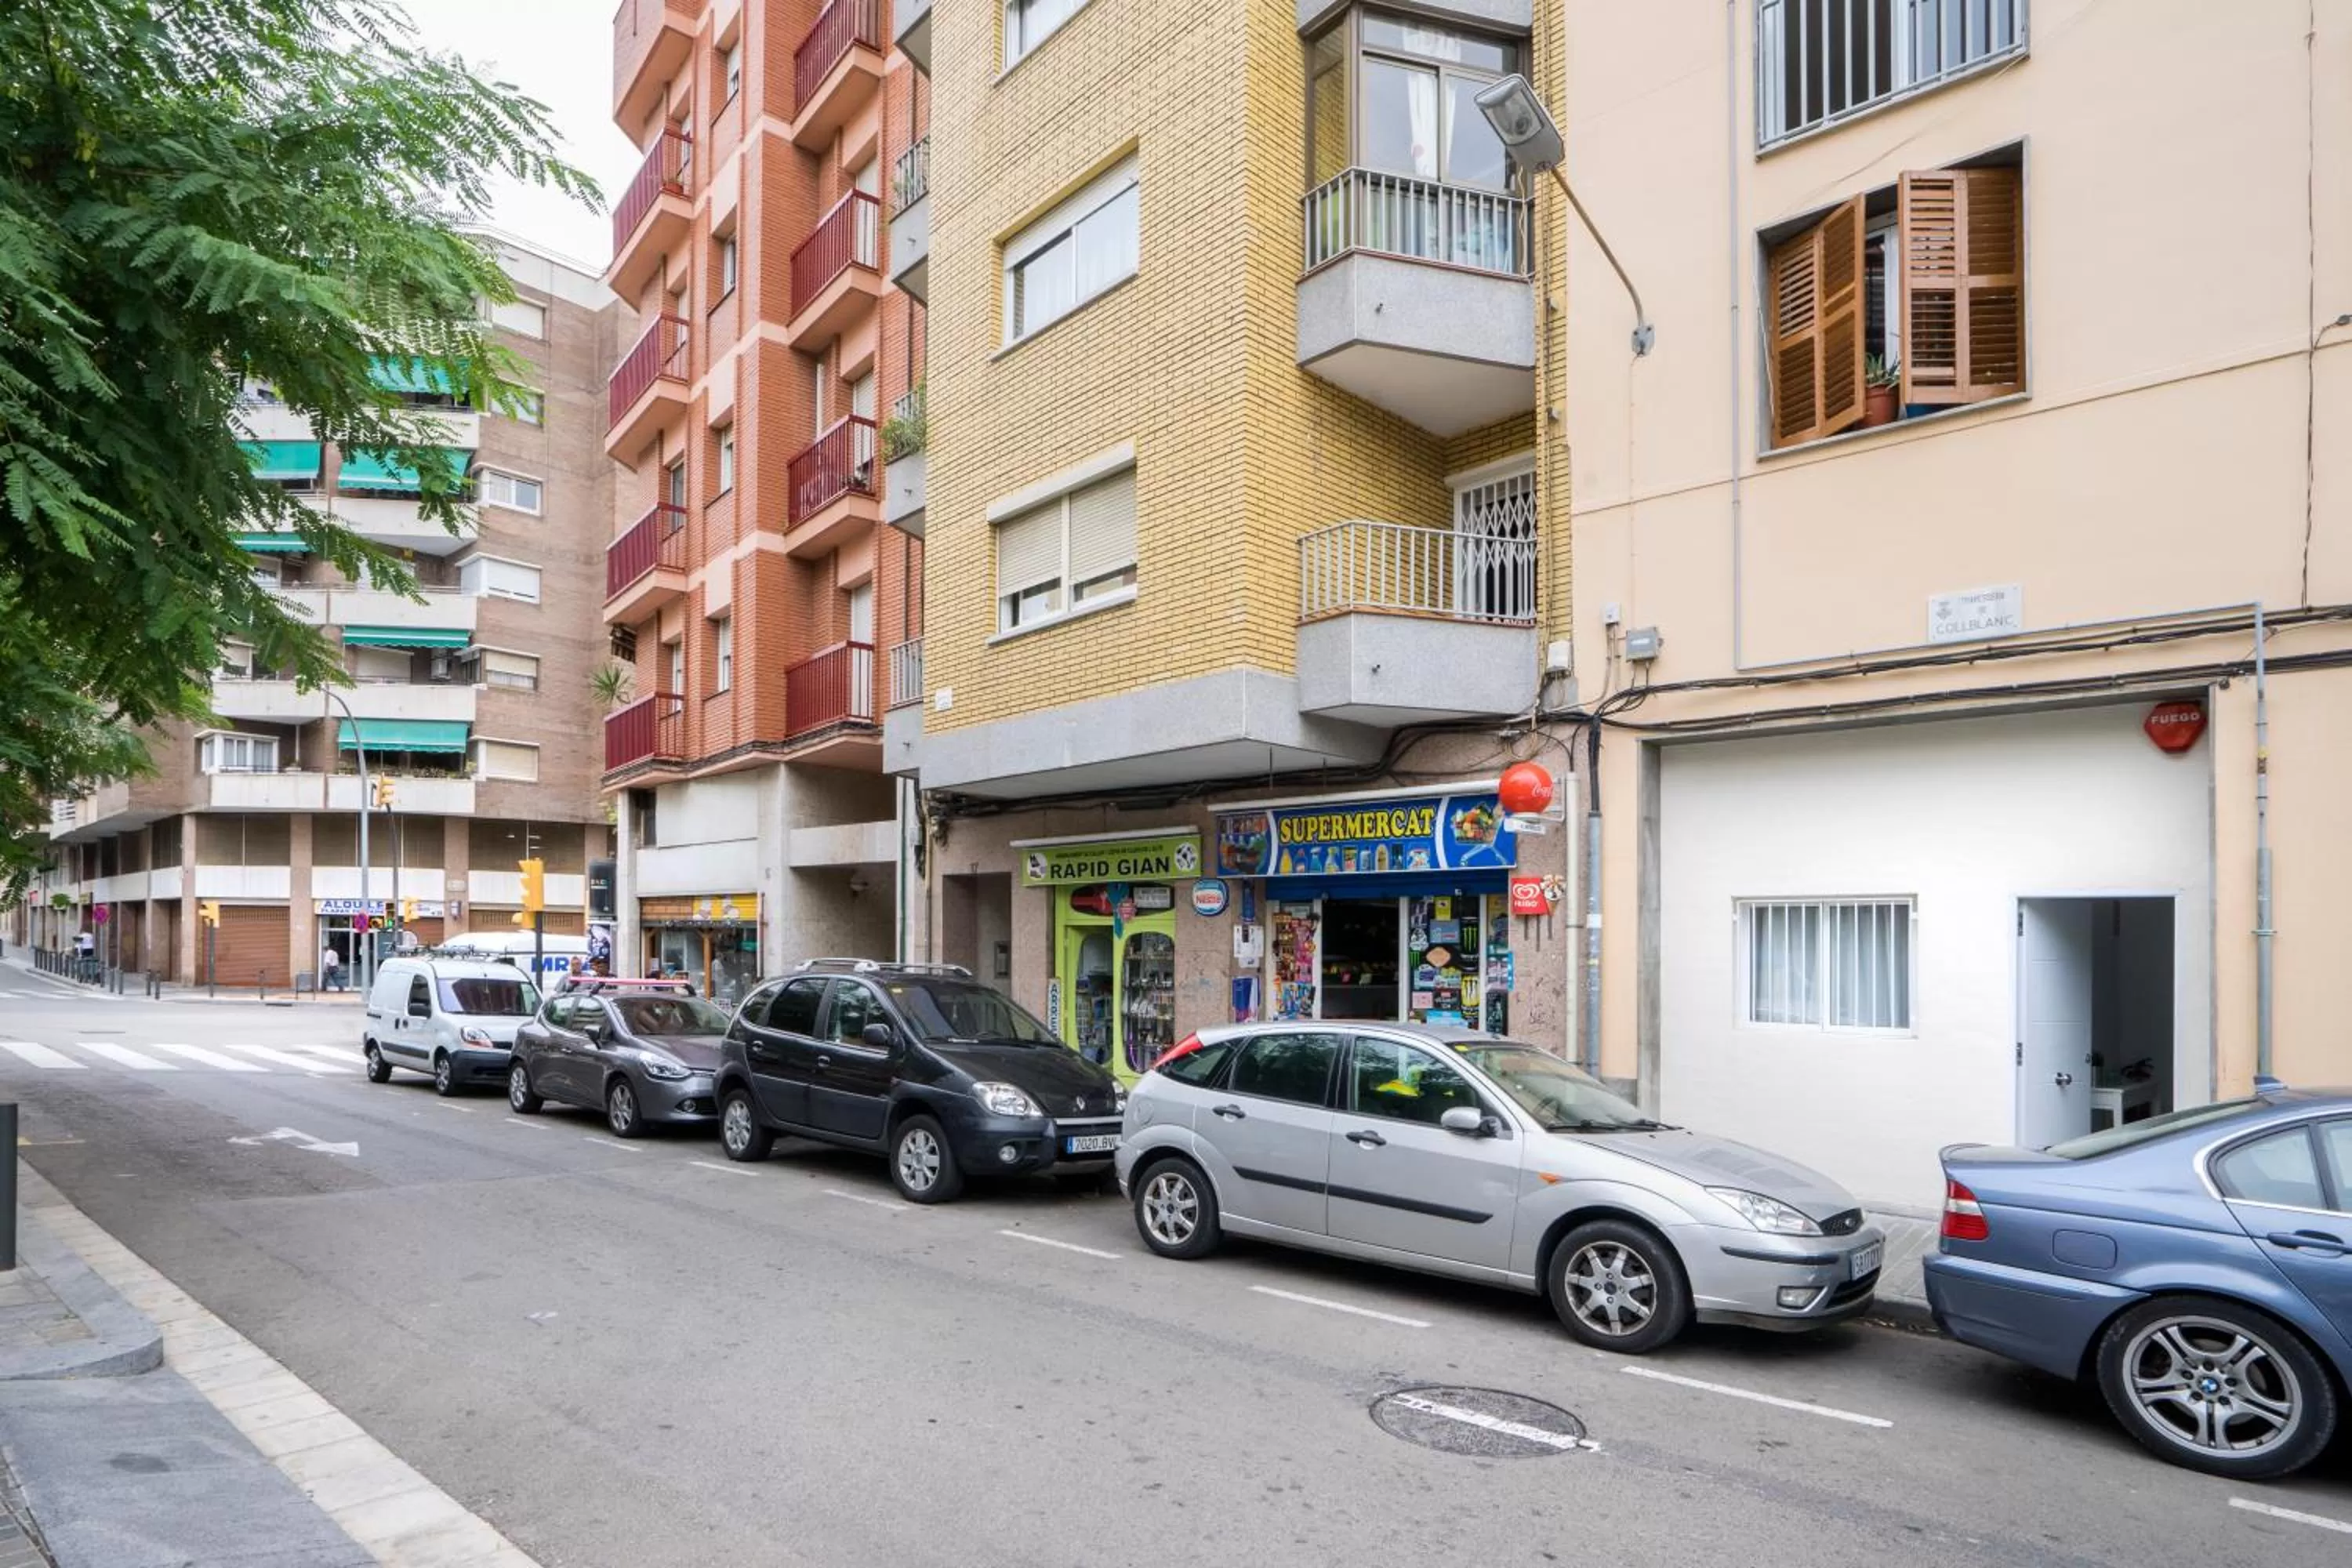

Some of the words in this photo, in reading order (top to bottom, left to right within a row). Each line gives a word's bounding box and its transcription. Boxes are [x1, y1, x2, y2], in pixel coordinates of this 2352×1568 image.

[1936, 615, 2014, 634] COLLBLANC
[2151, 712, 2200, 724] FUEGO
[1279, 808, 1436, 844] SUPERMERCAT
[1117, 856, 1170, 876] GIAN
